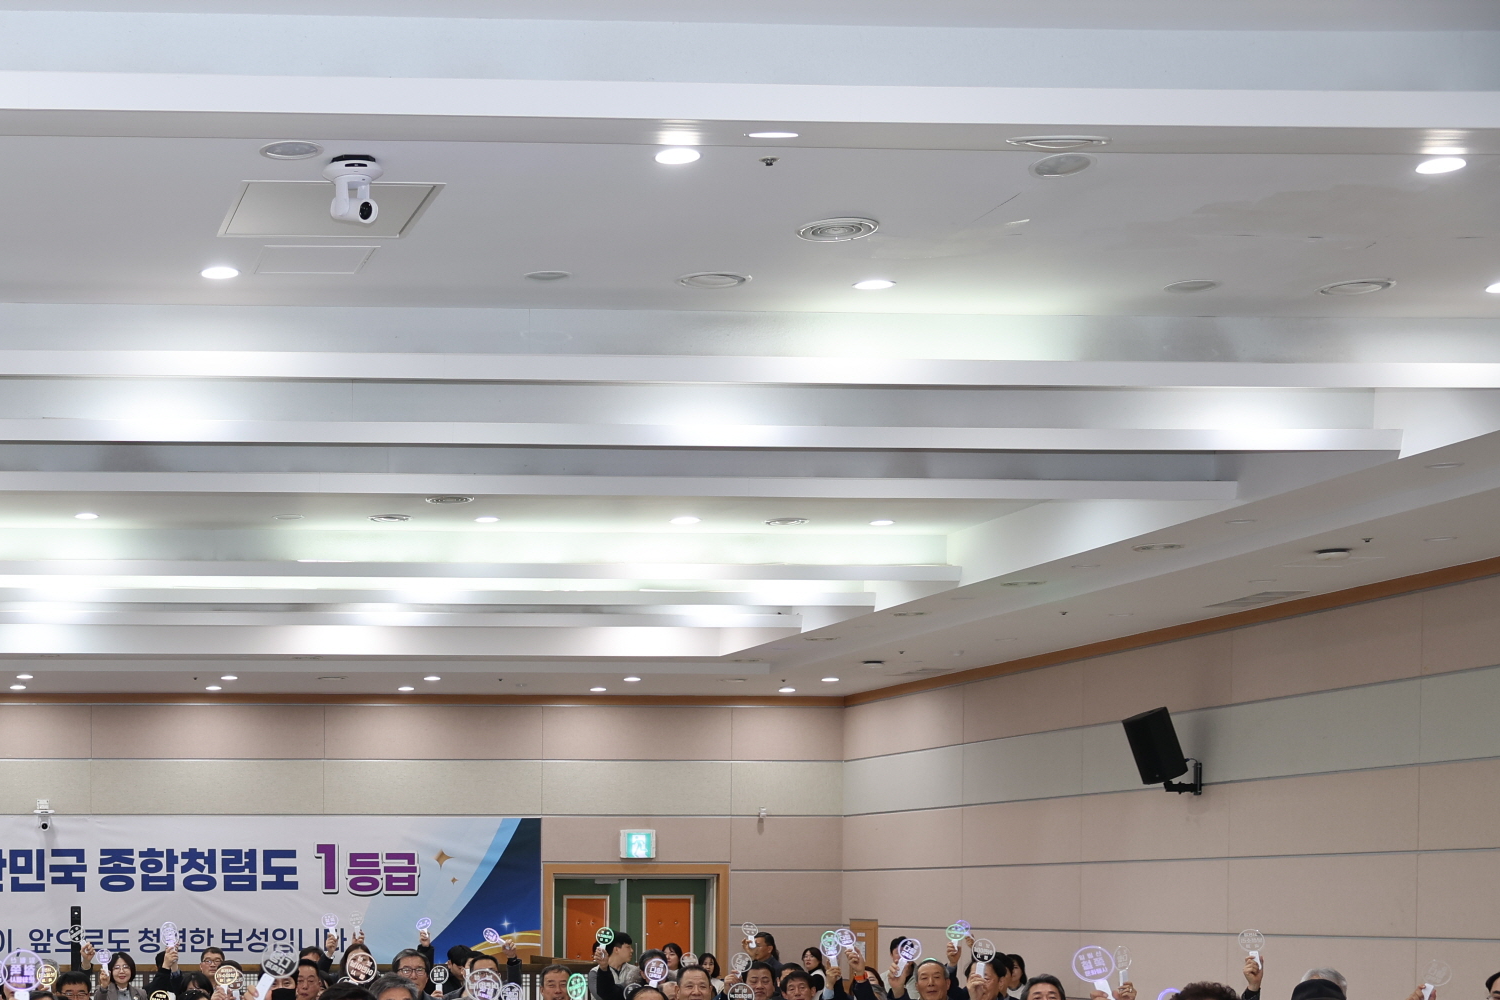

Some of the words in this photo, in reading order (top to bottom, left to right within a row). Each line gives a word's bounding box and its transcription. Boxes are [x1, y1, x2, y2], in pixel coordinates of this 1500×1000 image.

[98, 848, 299, 892] 종합청렴도
[315, 843, 418, 893] 1등급
[221, 928, 348, 954] 보성입니다
